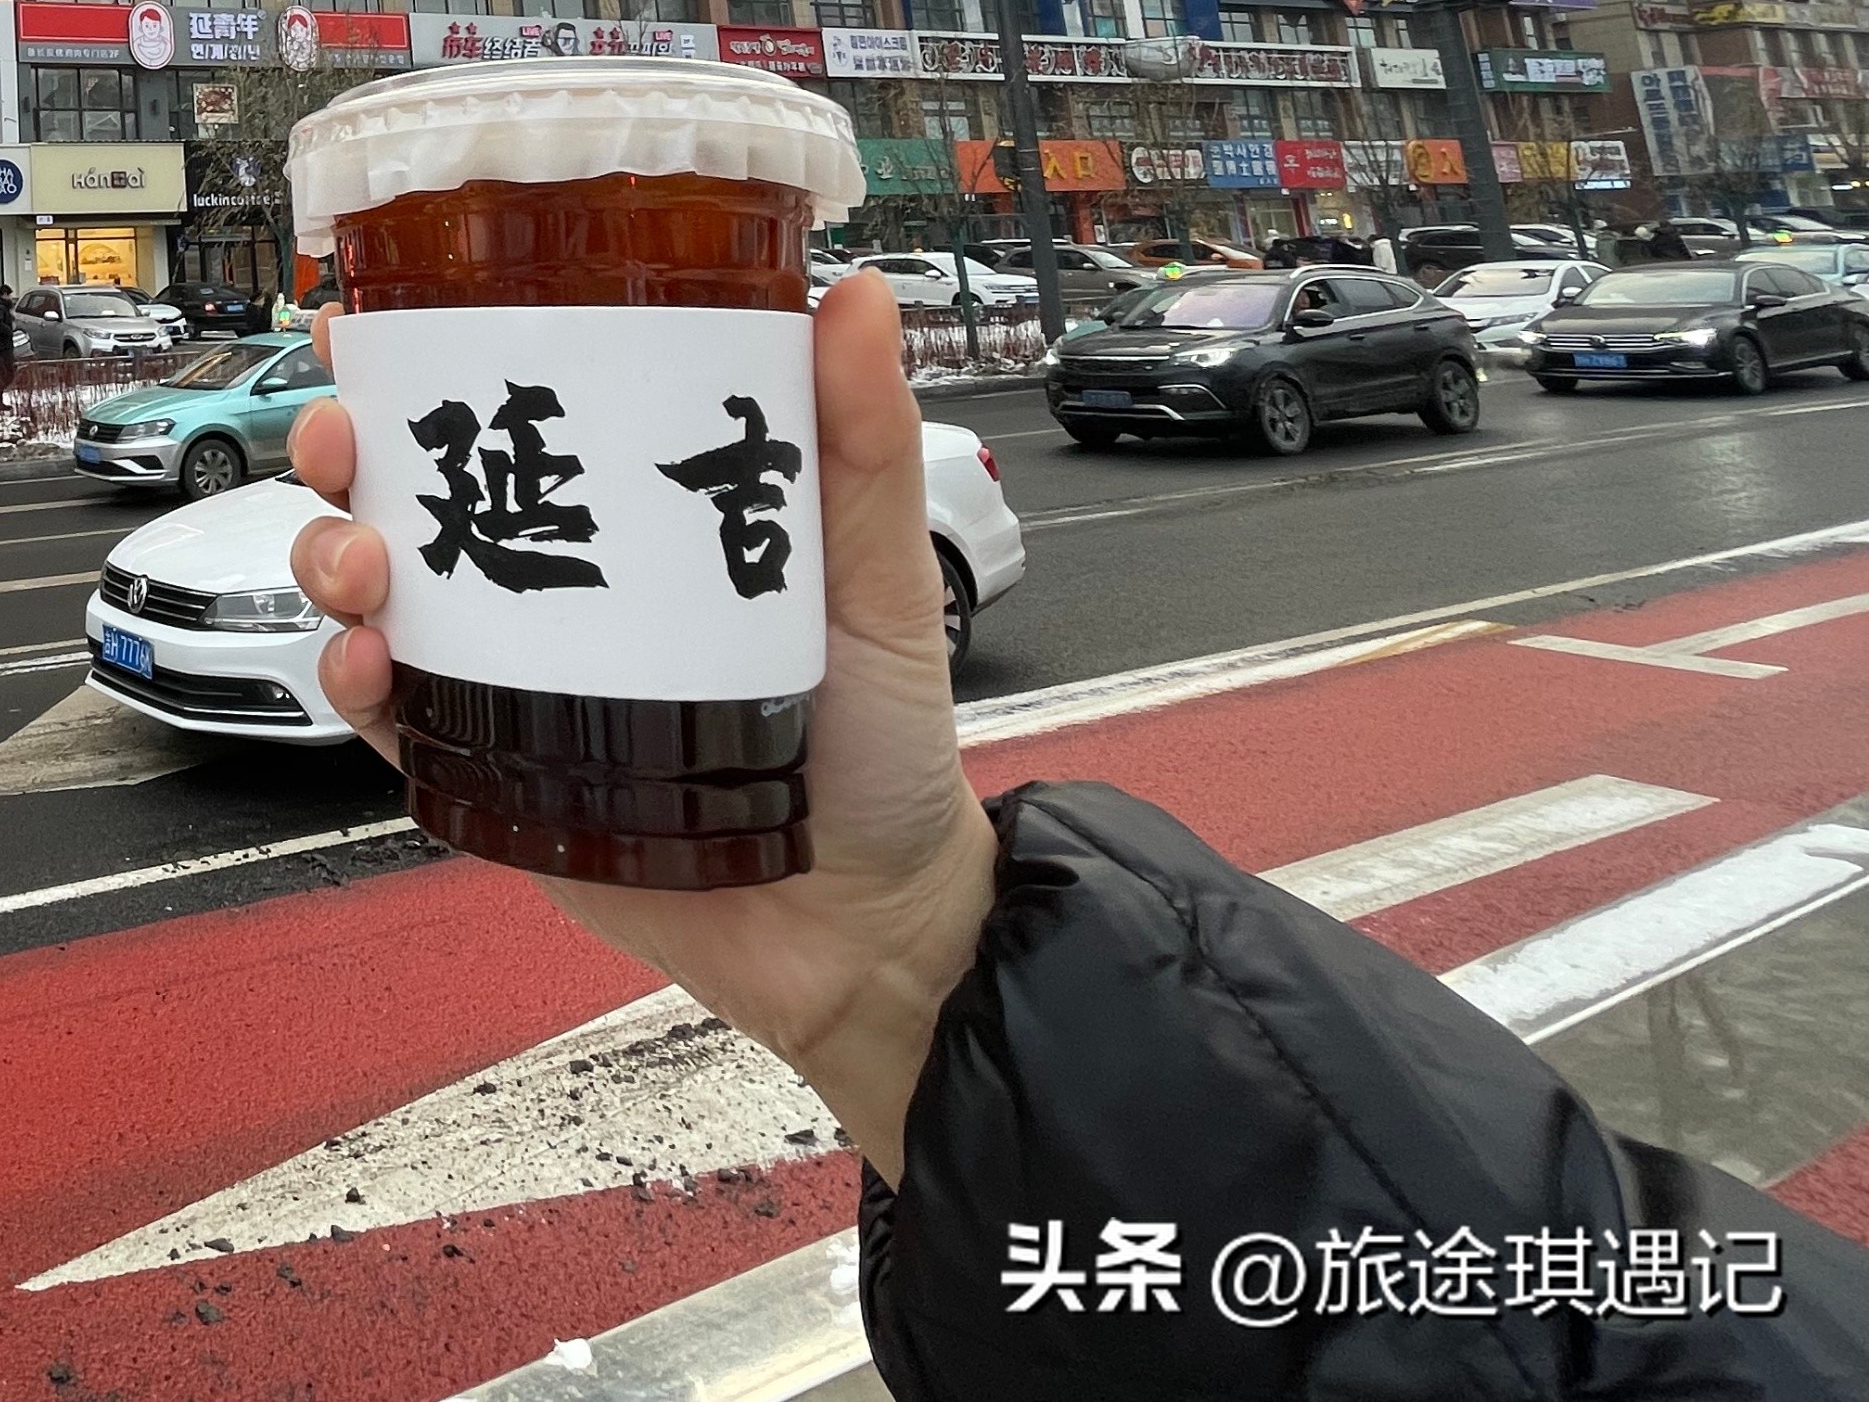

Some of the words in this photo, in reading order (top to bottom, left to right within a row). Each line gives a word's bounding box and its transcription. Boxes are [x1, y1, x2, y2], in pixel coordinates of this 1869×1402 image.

[521, 25, 542, 38] LIVE
[1043, 148, 1097, 180] 入口
[192, 192, 231, 207] luckin
[406, 378, 804, 600] 延吉
